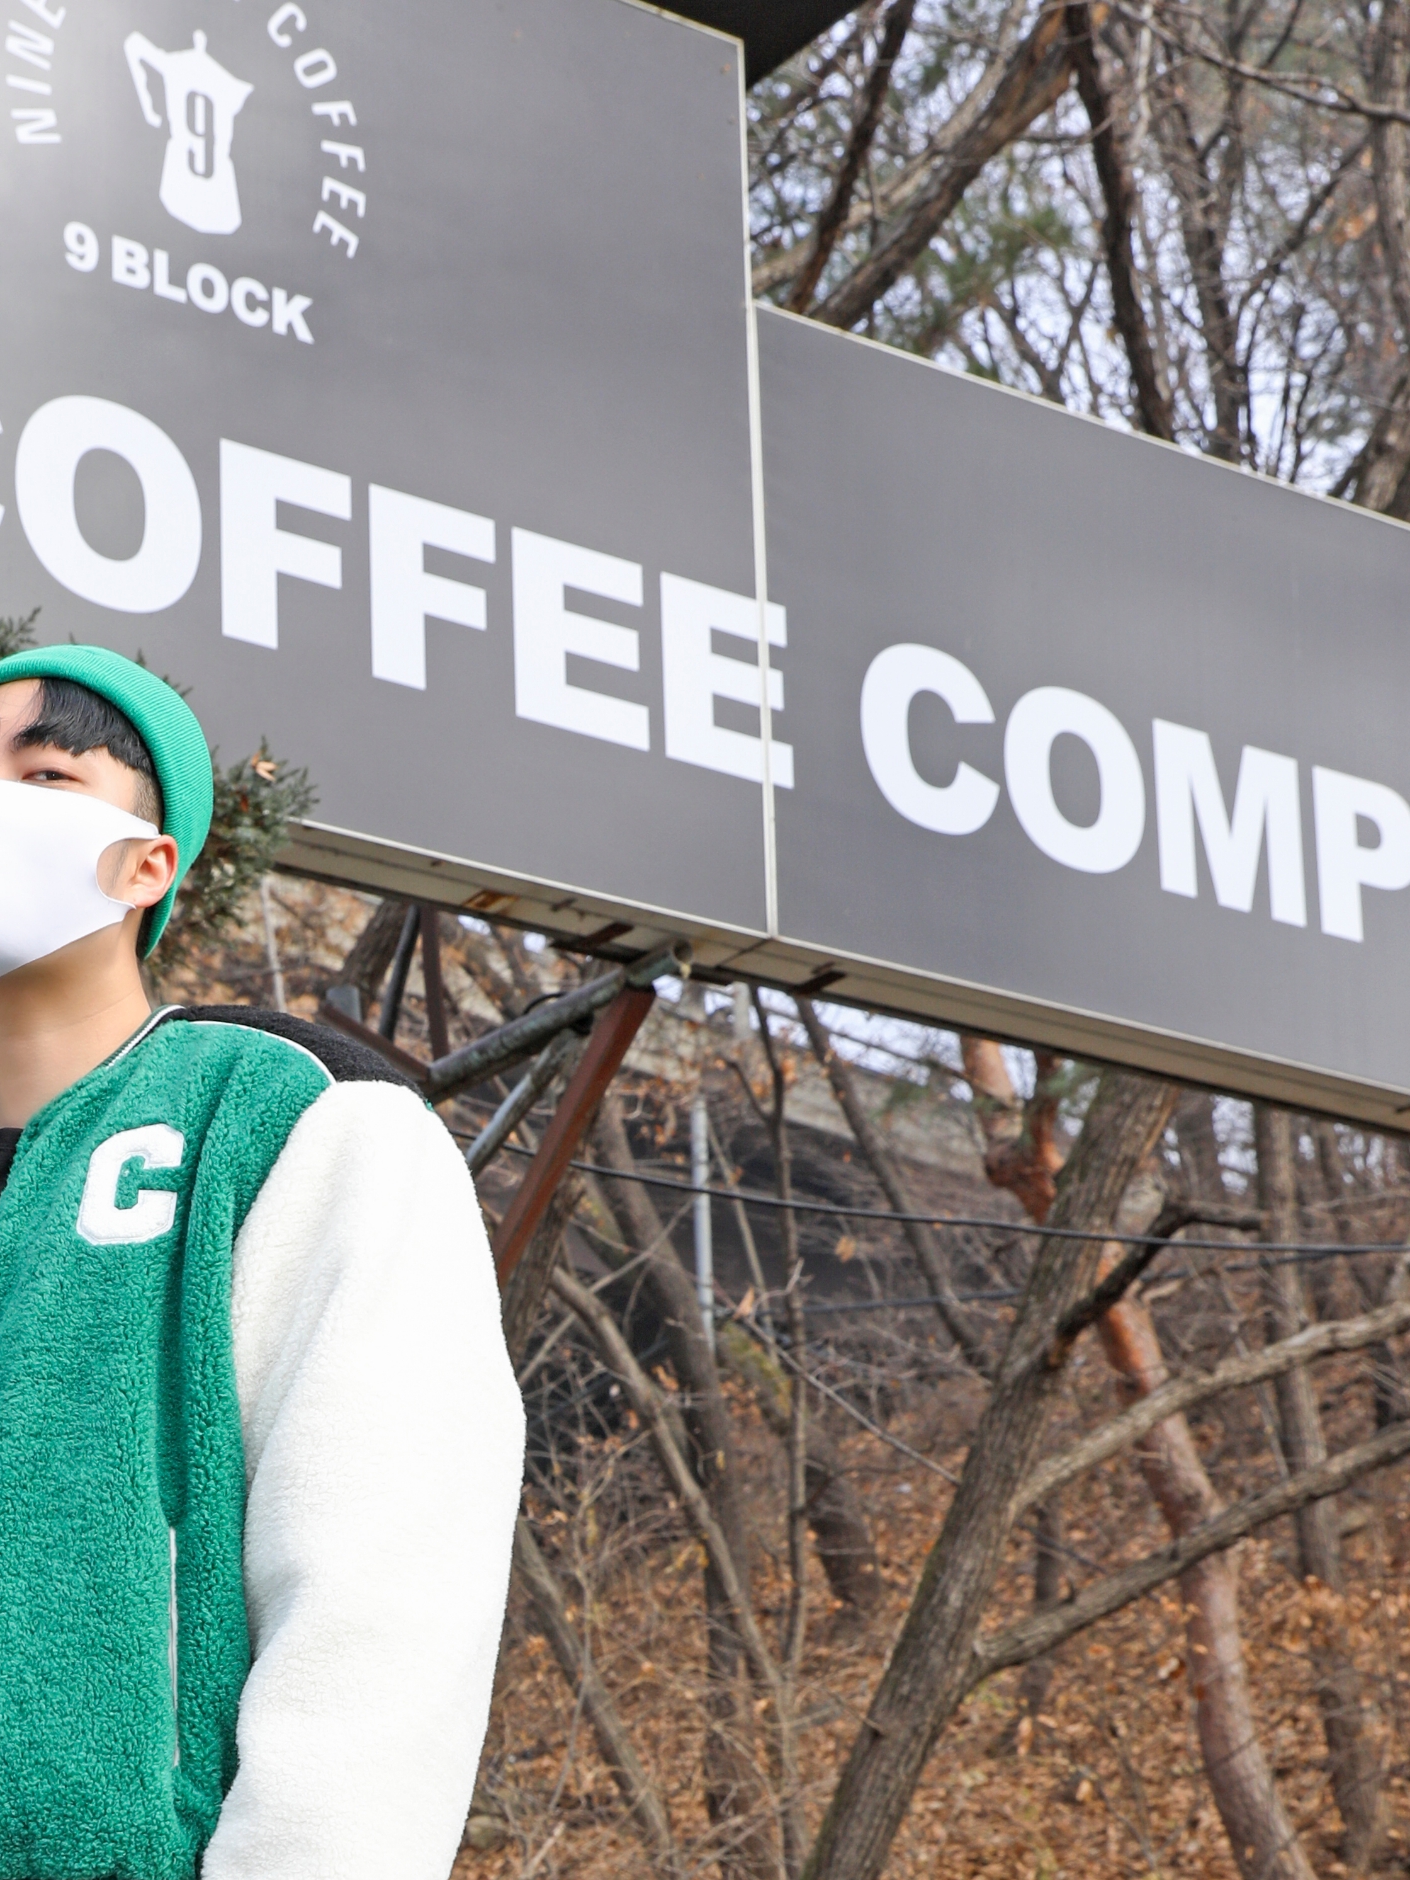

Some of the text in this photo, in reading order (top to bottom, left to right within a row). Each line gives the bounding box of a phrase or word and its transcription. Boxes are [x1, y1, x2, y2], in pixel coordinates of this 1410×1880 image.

[185, 90, 215, 179] 9
[267, 2, 366, 258] COFFEE
[63, 221, 315, 344] 9 BLOCK
[860, 642, 1410, 943] COMP
[76, 1123, 185, 1246] C
